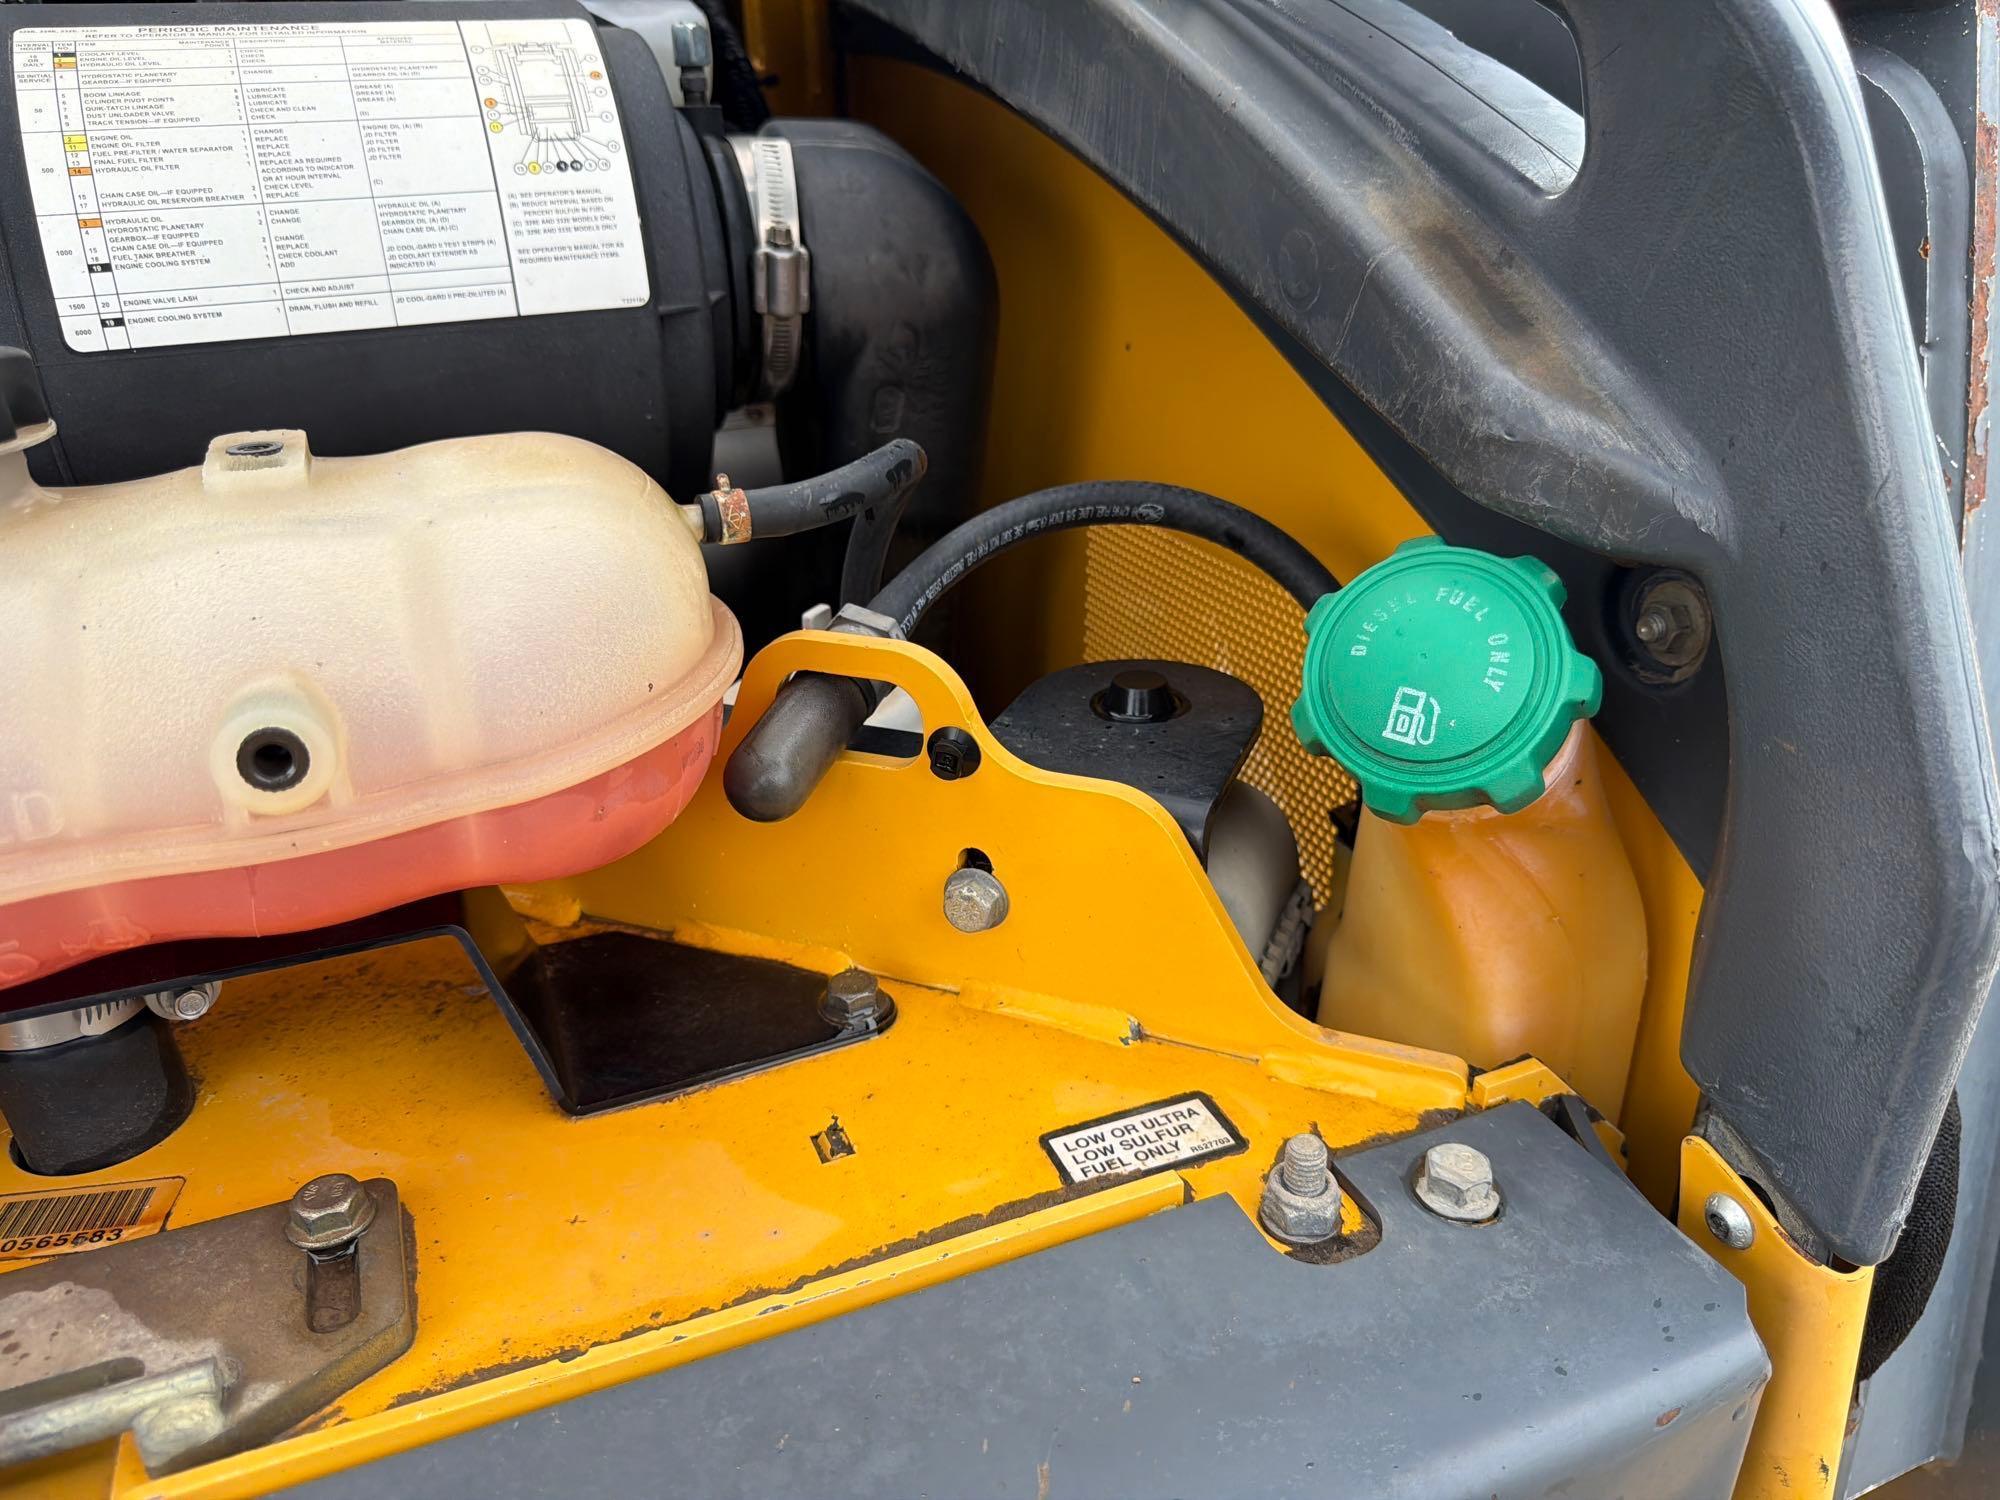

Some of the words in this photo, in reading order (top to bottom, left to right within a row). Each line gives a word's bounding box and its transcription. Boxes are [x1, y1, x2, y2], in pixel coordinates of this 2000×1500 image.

[175, 188, 214, 196] EQUIPPED
[101, 200, 146, 209] HYDRAULIC
[161, 197, 205, 205] RESERVOIR
[205, 195, 246, 203] BREATHER
[105, 218, 150, 226] HYDRAULIC
[107, 226, 160, 234] HYDROSTATIC
[161, 224, 205, 232] PLANETARY
[186, 240, 225, 248] EQUIPPED
[155, 251, 197, 259] BREATHER
[285, 287, 311, 295] CHECK
[327, 284, 355, 292] ADJUST
[354, 300, 378, 308] REFILL
[157, 314, 192, 322] COOLING
[193, 312, 224, 320] SYSTEM
[1350, 592, 1417, 656] DIESEL
[1435, 587, 1490, 622] FUEL
[1483, 633, 1510, 693] ONLY
[1063, 1131, 1106, 1153] LOW
[1110, 1123, 1139, 1139] OR
[1139, 1107, 1201, 1129] ULTRA
[1071, 1143, 1115, 1165] LOW
[1119, 1123, 1195, 1151] SULFUR
[1190, 1137, 1231, 1153] R527703
[1080, 1156, 1132, 1178] FUEL
[1133, 1139, 1182, 1162] ONLY
